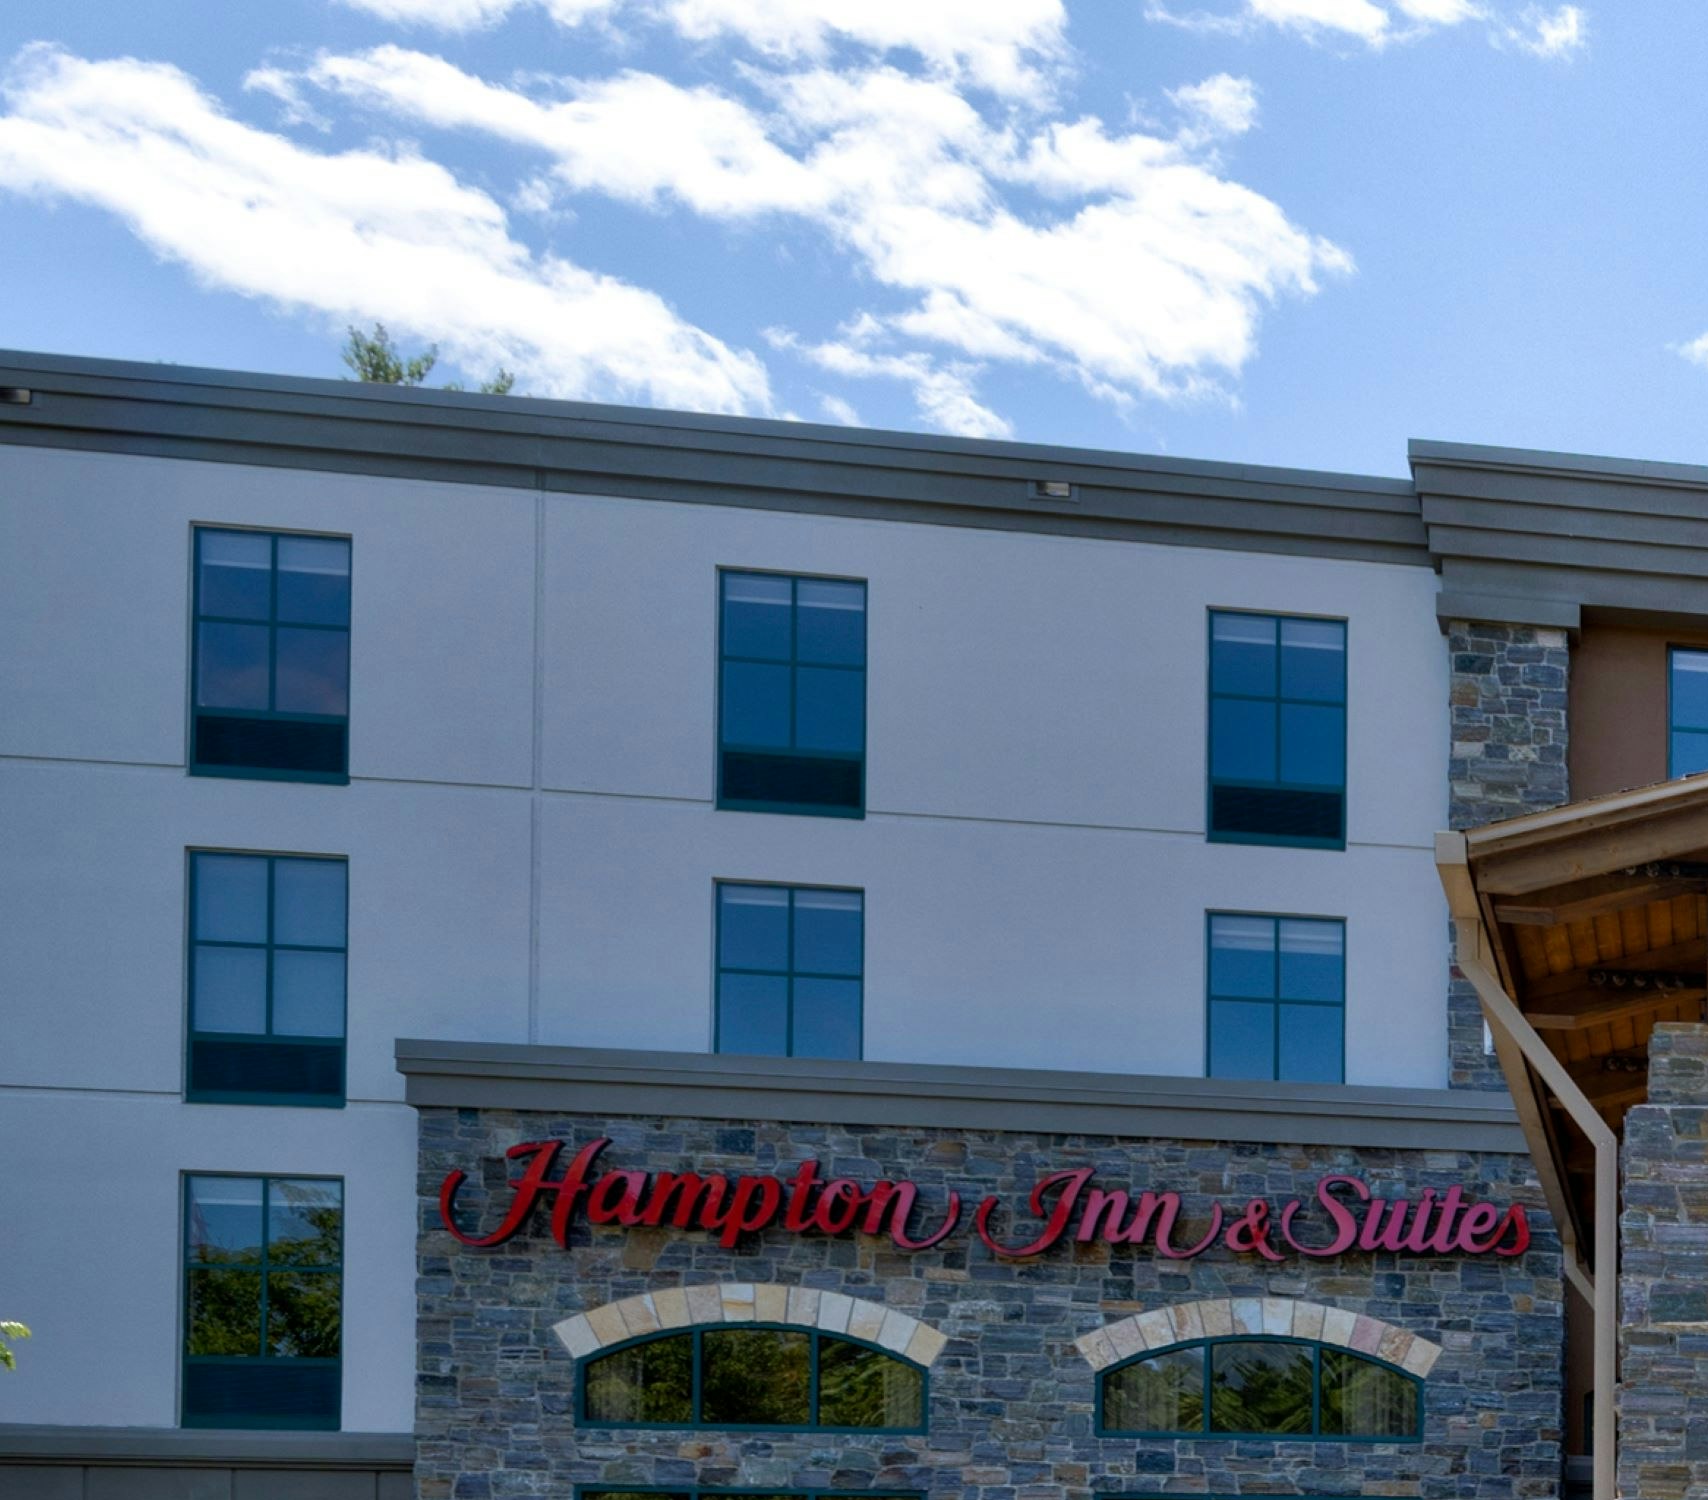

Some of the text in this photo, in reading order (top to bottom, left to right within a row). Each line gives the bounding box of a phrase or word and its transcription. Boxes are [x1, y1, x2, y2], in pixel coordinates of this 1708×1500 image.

[439, 1137, 1531, 1261] Hampton Inn & Suites
